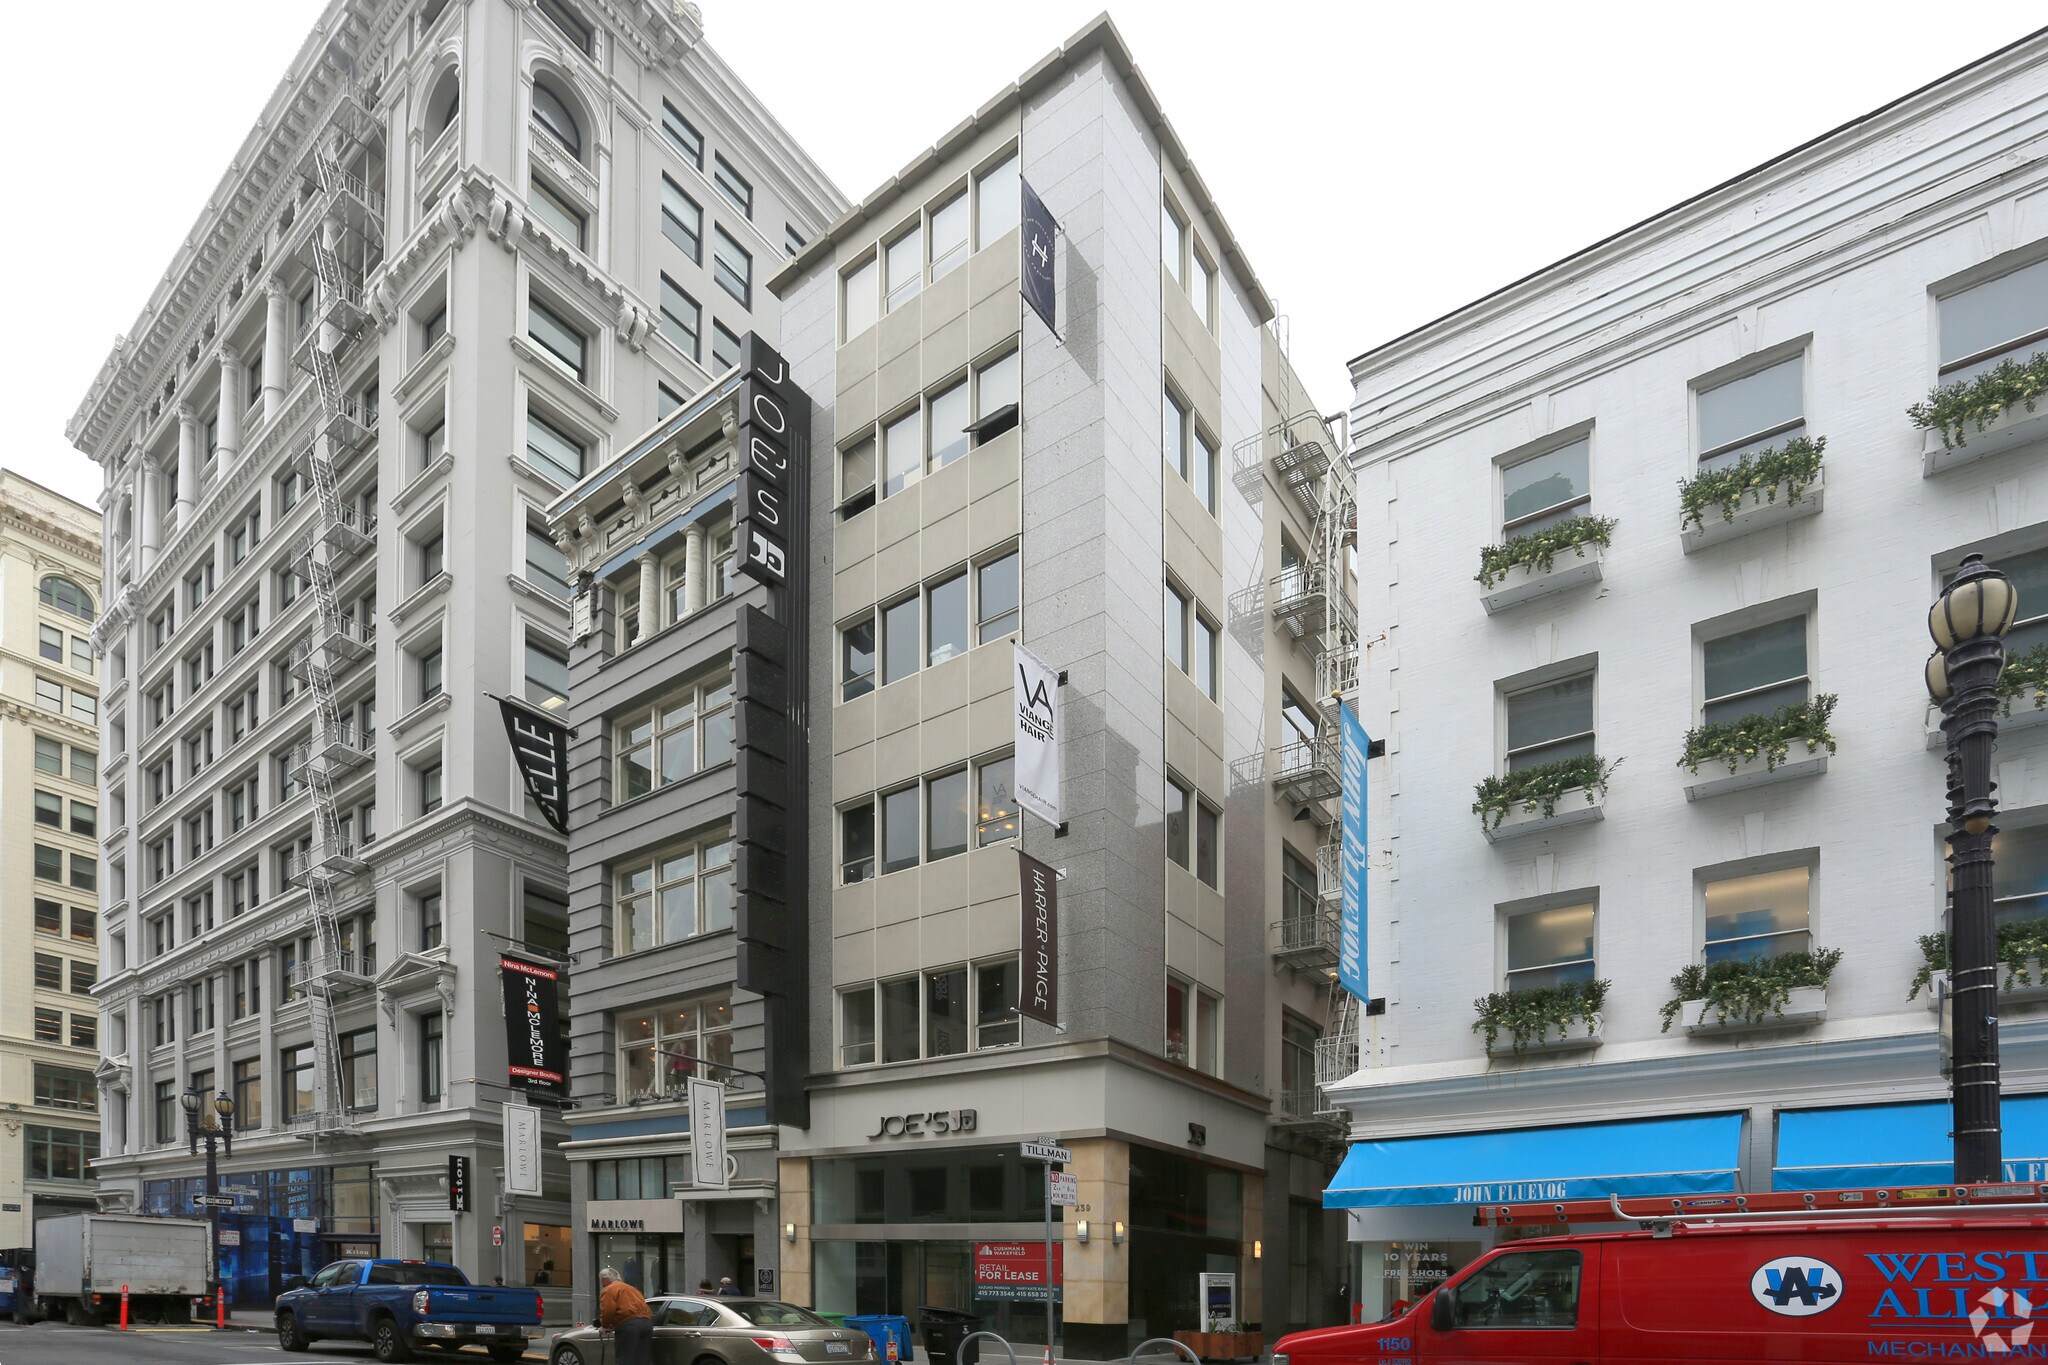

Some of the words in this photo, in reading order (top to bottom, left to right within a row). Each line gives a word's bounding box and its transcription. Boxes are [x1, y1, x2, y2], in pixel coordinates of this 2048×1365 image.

[1019, 702, 1053, 736] VIANGE
[1020, 720, 1045, 743] HAIR
[1343, 722, 1366, 826] JOHN
[1033, 868, 1048, 943] HARPER
[1343, 828, 1366, 980] FLUEVOG
[504, 960, 519, 970] Nina
[1034, 950, 1048, 1011] PAIGE
[525, 976, 539, 1006] NINA
[511, 1067, 539, 1077] Designer
[866, 1111, 949, 1138] JOE'S
[703, 1100, 715, 1169] MARLOWE
[518, 1121, 528, 1178] MARLOWE
[1026, 1144, 1067, 1160] TILLMAN
[452, 1157, 464, 1211] Kiton
[1059, 1175, 1076, 1184] PARKING
[1453, 1185, 1492, 1203] JOHN
[1498, 1182, 1566, 1201] FLUEVOG
[1075, 1204, 1091, 1213] 239
[591, 1219, 645, 1230] MARLOWE
[1403, 1242, 1428, 1251] WIN
[1384, 1252, 1399, 1261] 10
[1404, 1252, 1448, 1261] YEARS
[979, 1263, 1009, 1271] RETAIL
[979, 1271, 1001, 1280] FOR
[1004, 1271, 1039, 1280] LEASE
[1384, 1269, 1409, 1277] FREE
[1412, 1269, 1448, 1277] SHOES
[1377, 1337, 1411, 1351] 1150
